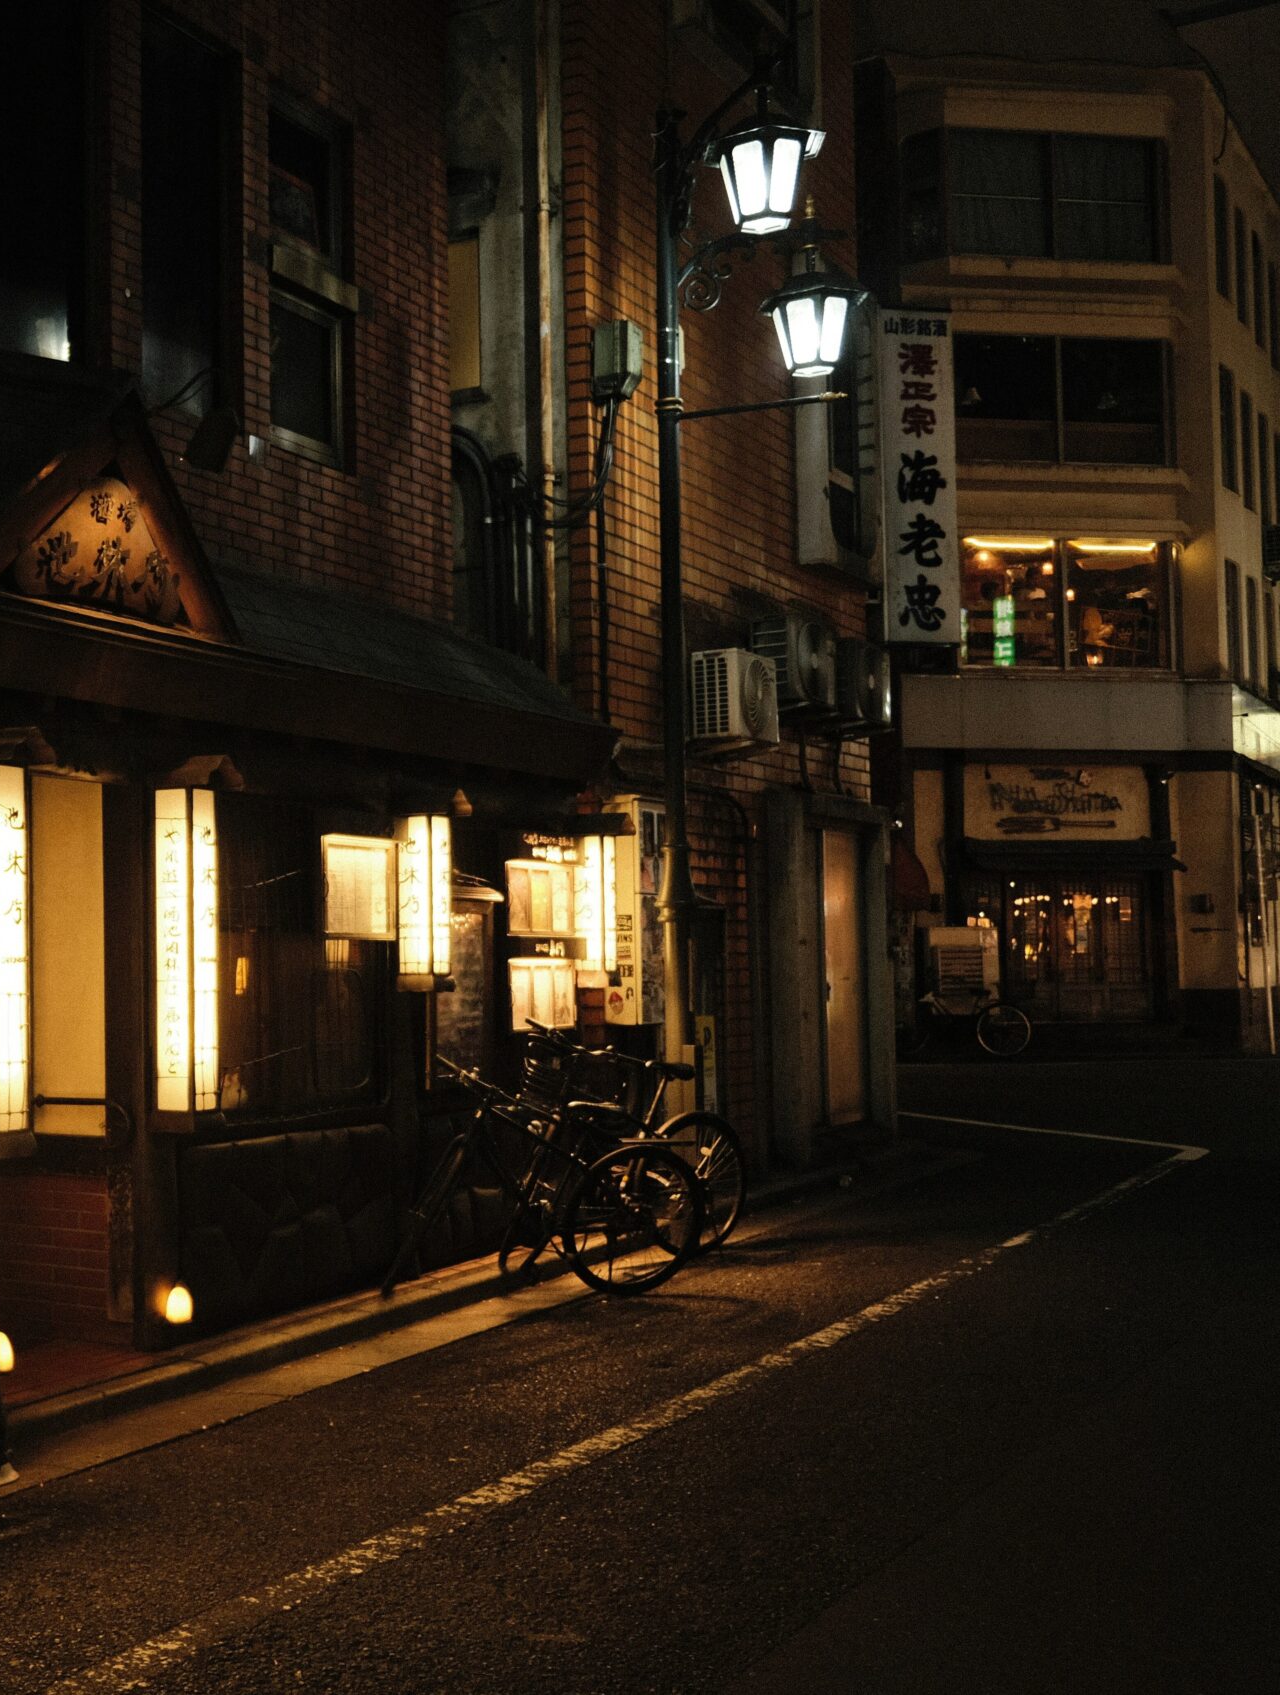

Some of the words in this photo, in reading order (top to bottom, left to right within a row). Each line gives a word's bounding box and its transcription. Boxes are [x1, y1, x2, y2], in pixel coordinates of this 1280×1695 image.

[884, 317, 948, 337] 山形銘酒
[897, 450, 947, 632] 海老忠
